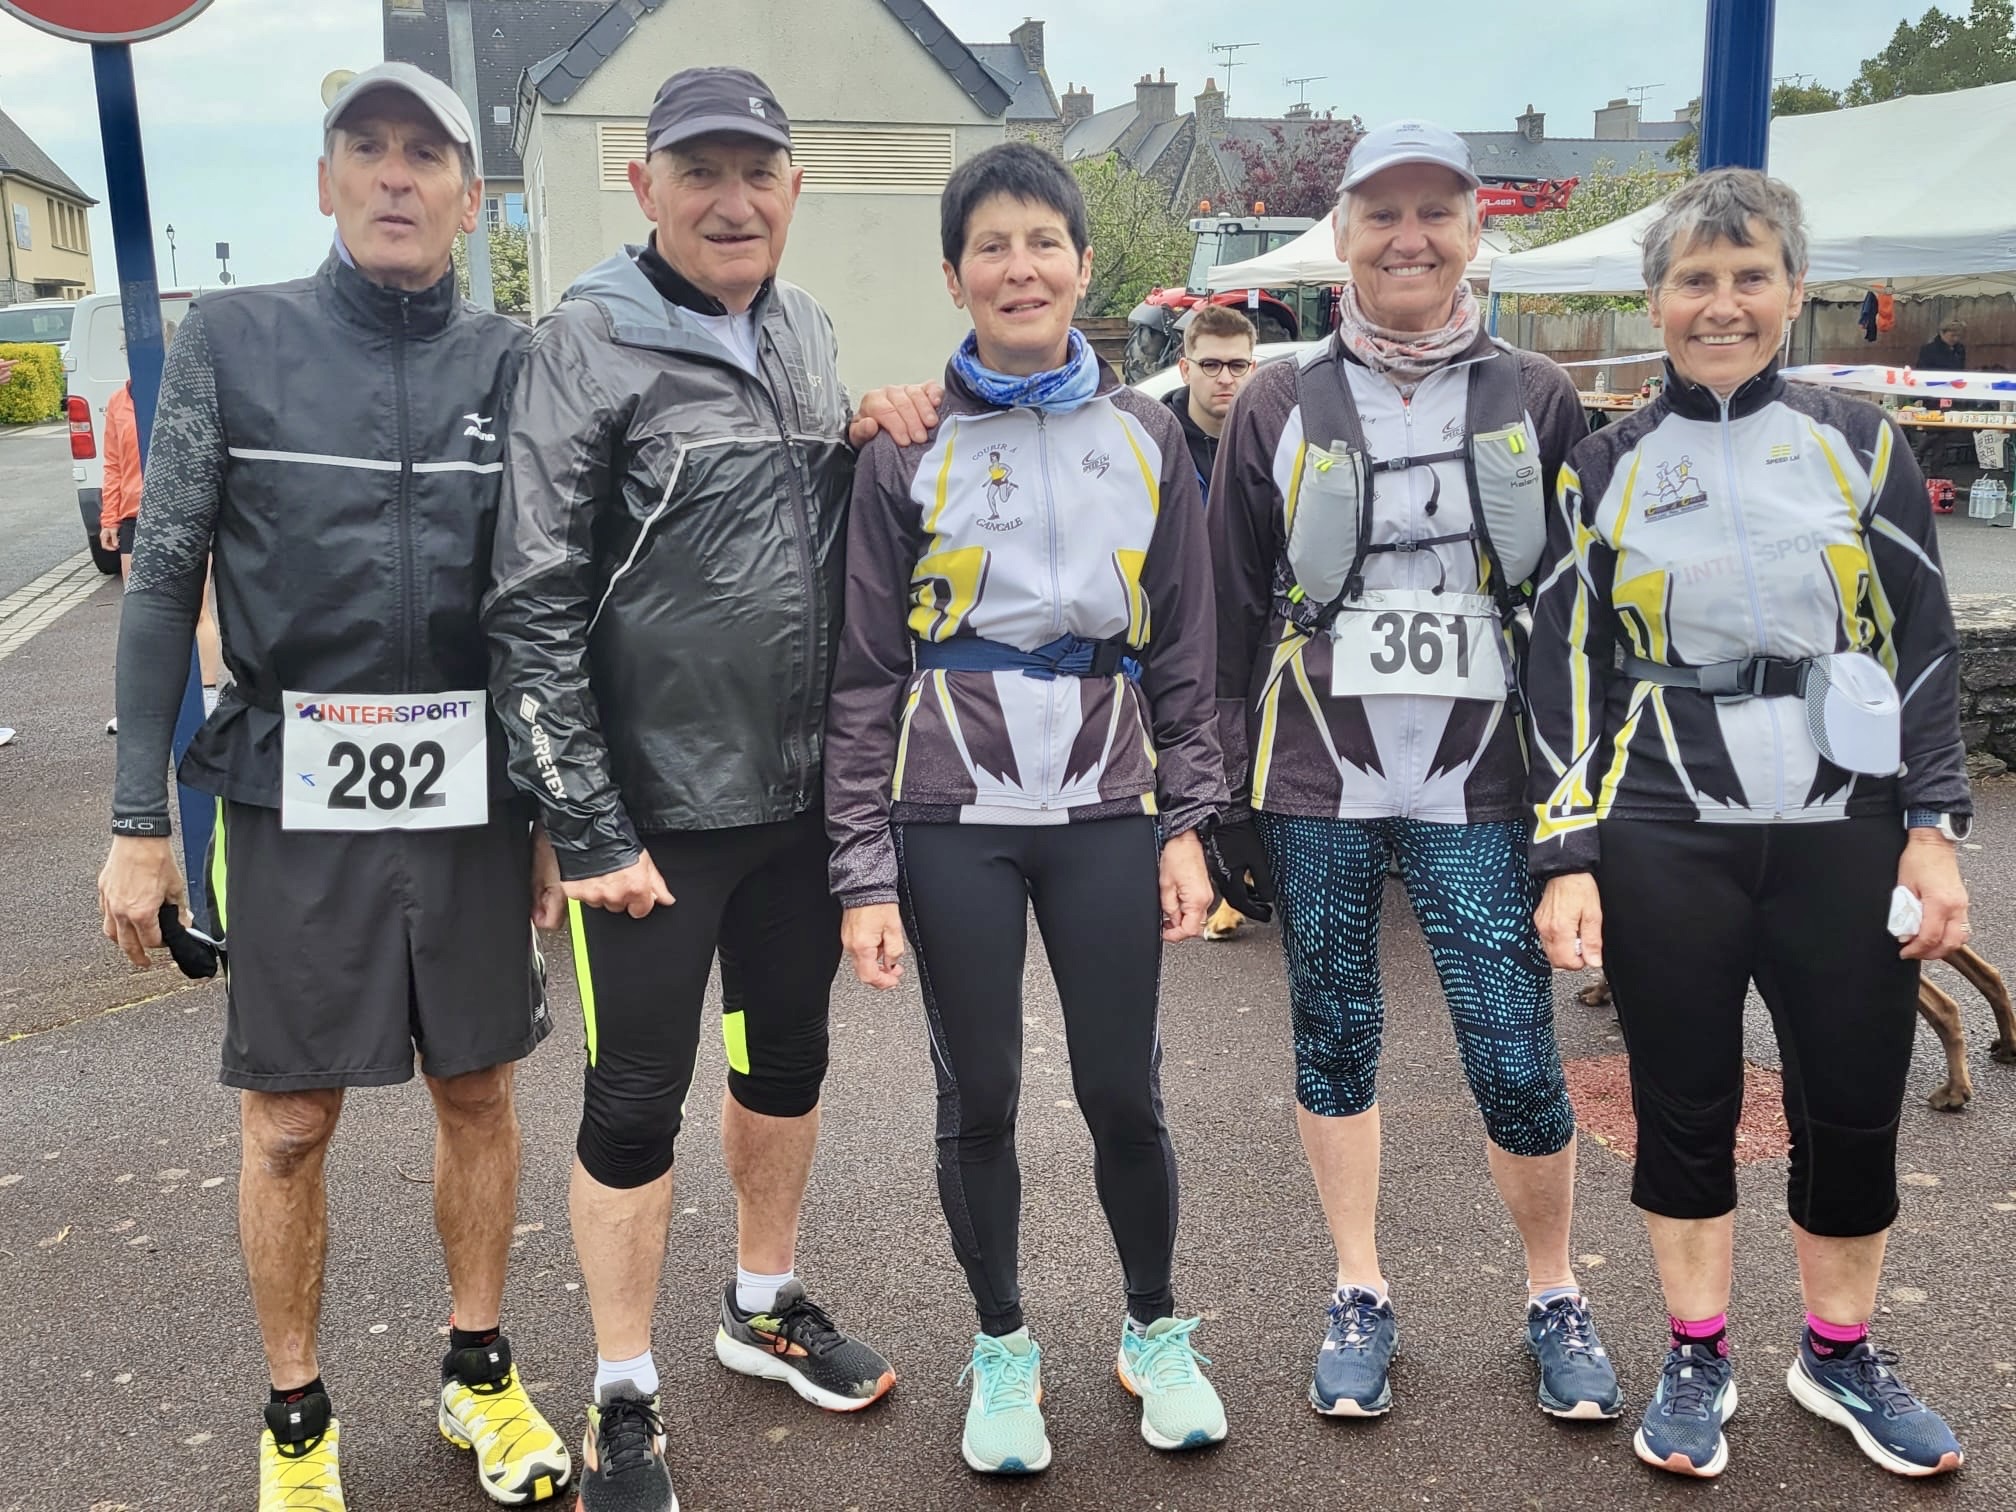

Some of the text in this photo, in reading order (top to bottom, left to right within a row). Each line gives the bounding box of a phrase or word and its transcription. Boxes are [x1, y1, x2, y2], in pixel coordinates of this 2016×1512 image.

[1369, 611, 1469, 679] 361
[318, 700, 472, 724] INTERSPORT
[327, 740, 446, 811] 282
[531, 723, 568, 800] GORE-TEX
